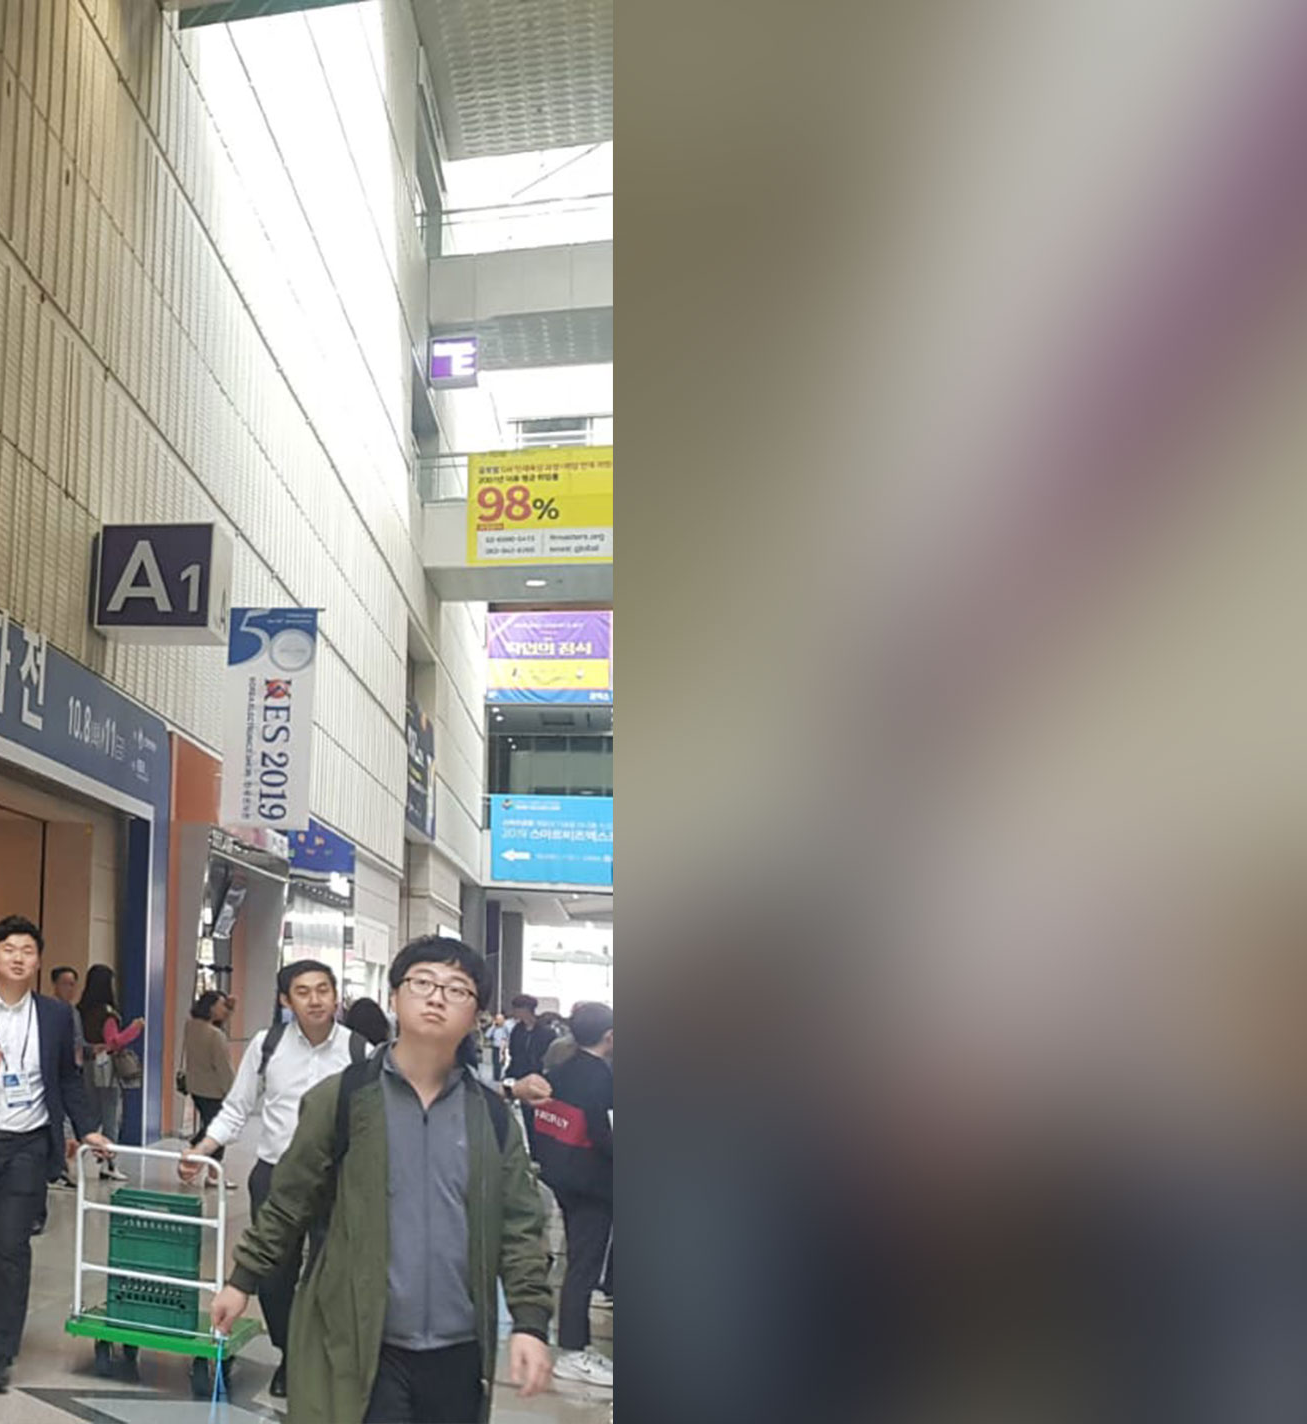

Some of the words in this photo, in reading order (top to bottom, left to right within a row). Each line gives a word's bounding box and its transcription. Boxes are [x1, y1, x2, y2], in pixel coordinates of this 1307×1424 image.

[477, 485, 560, 522] 98%
[106, 539, 202, 613] A1
[257, 751, 290, 820] 2019
